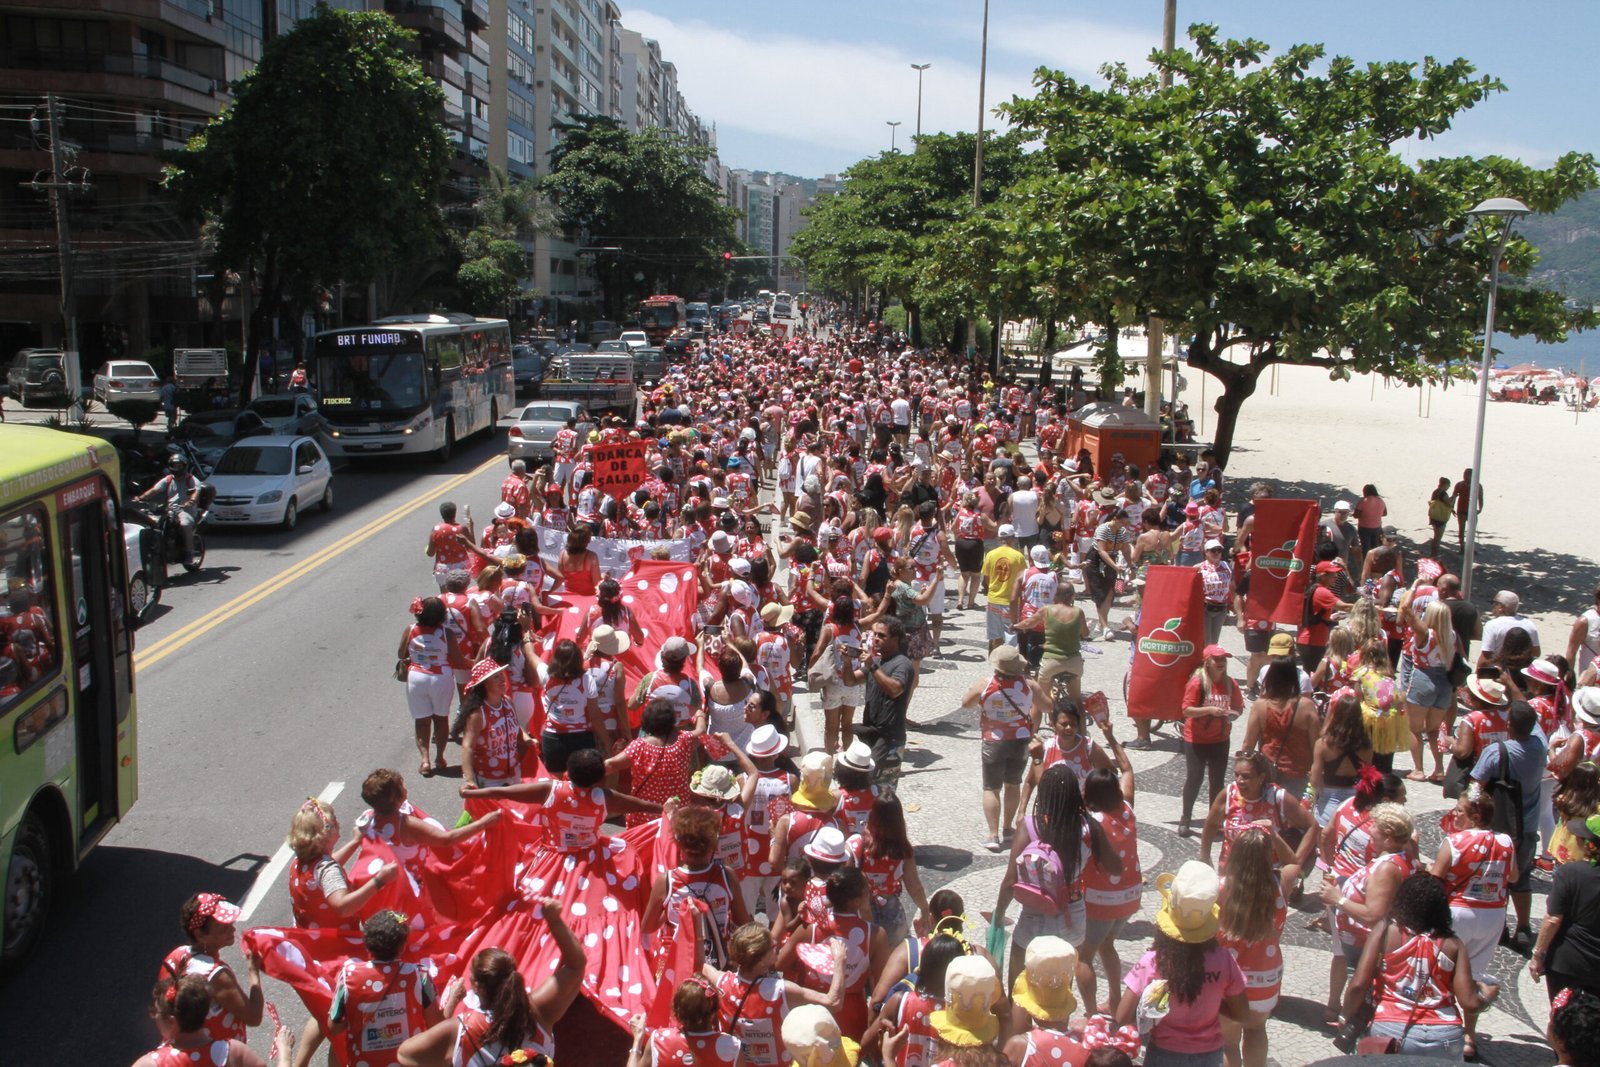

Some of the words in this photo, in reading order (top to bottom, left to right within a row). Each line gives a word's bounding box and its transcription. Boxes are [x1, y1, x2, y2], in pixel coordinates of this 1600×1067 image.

[337, 335, 356, 346] BRT
[323, 397, 352, 405] FIOCRUZ
[611, 461, 627, 471] DE
[63, 482, 96, 506] EMBARQUE
[1259, 559, 1300, 569] HORTIFRUTI
[1140, 641, 1189, 652] HORTIFRUTI
